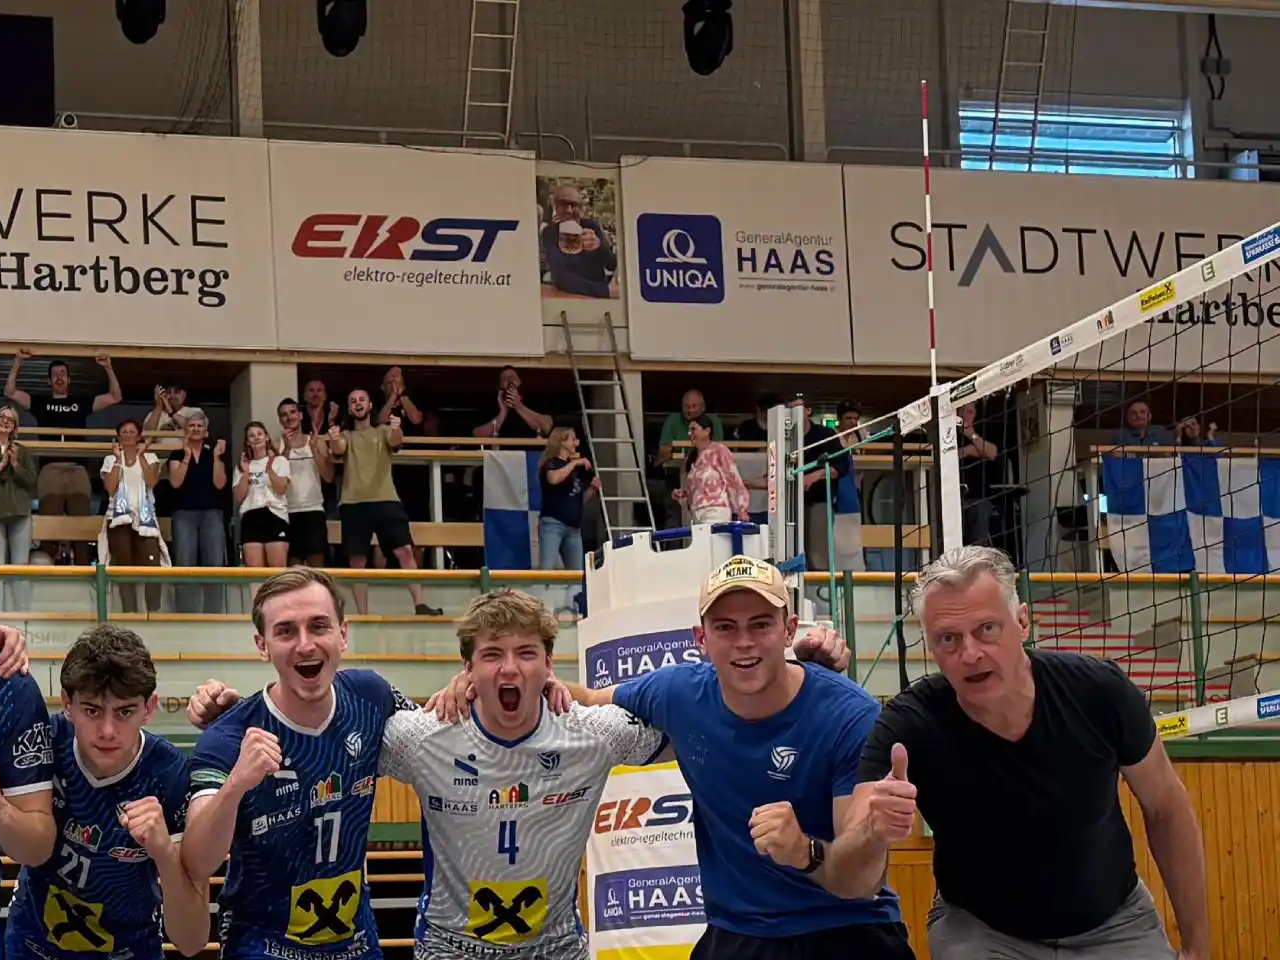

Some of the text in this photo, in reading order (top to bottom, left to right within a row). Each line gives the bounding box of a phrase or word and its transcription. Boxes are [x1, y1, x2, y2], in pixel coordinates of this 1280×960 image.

[736, 230, 833, 247] GeneralAgentur
[737, 247, 835, 276] HAAS
[344, 266, 512, 288] elektro-regeltechnik.at
[645, 268, 718, 290] UNIQA
[725, 566, 753, 578] MIAMI
[275, 780, 299, 797] nine
[453, 777, 479, 786] nine
[269, 807, 302, 826] HAAS
[444, 802, 479, 813] HAAS
[314, 811, 344, 864] 17
[497, 820, 520, 865] 4
[611, 829, 693, 847] elektro-regeltechn
[57, 842, 92, 889] 21
[628, 875, 701, 889] GeneralAgent
